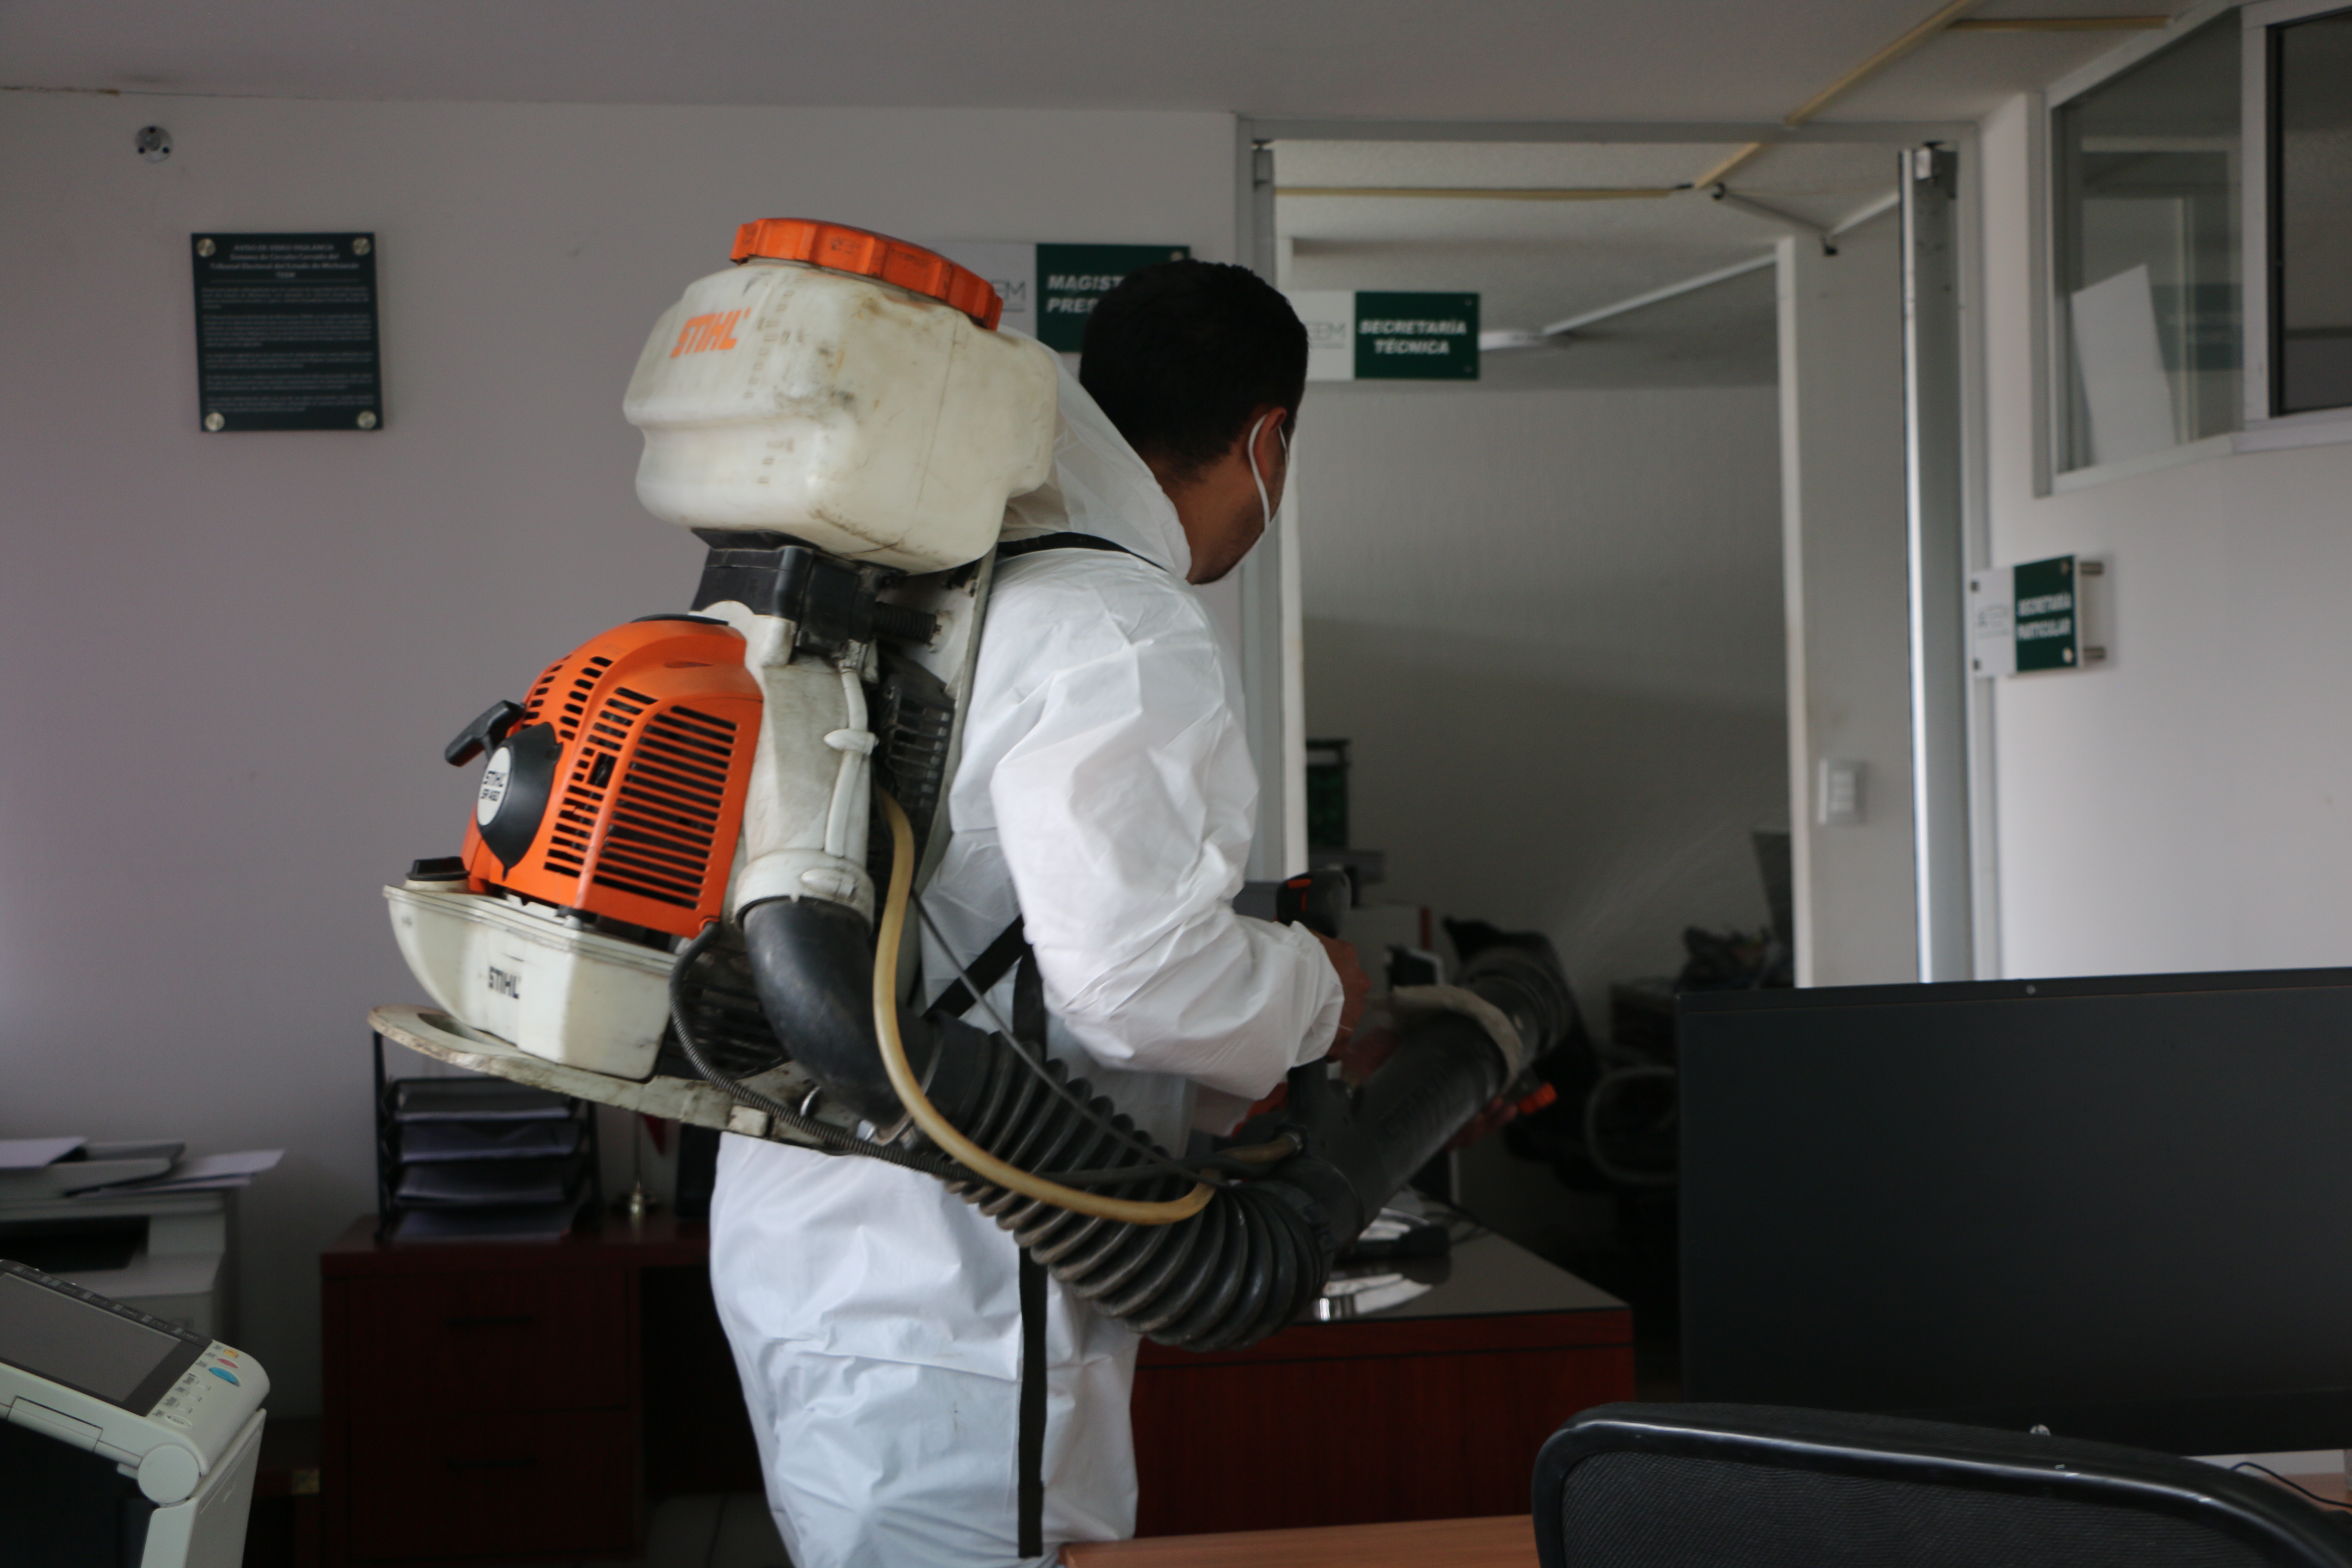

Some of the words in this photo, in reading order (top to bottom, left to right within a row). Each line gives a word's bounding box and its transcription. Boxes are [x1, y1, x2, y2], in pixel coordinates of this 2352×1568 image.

[1047, 274, 1125, 291] MAGIST
[1046, 297, 1099, 314] PRES
[670, 309, 744, 358] STIHL
[1358, 317, 1467, 336] SECRETARÍA
[1373, 337, 1451, 355] TÉCNICA
[489, 966, 520, 999] STIHL
